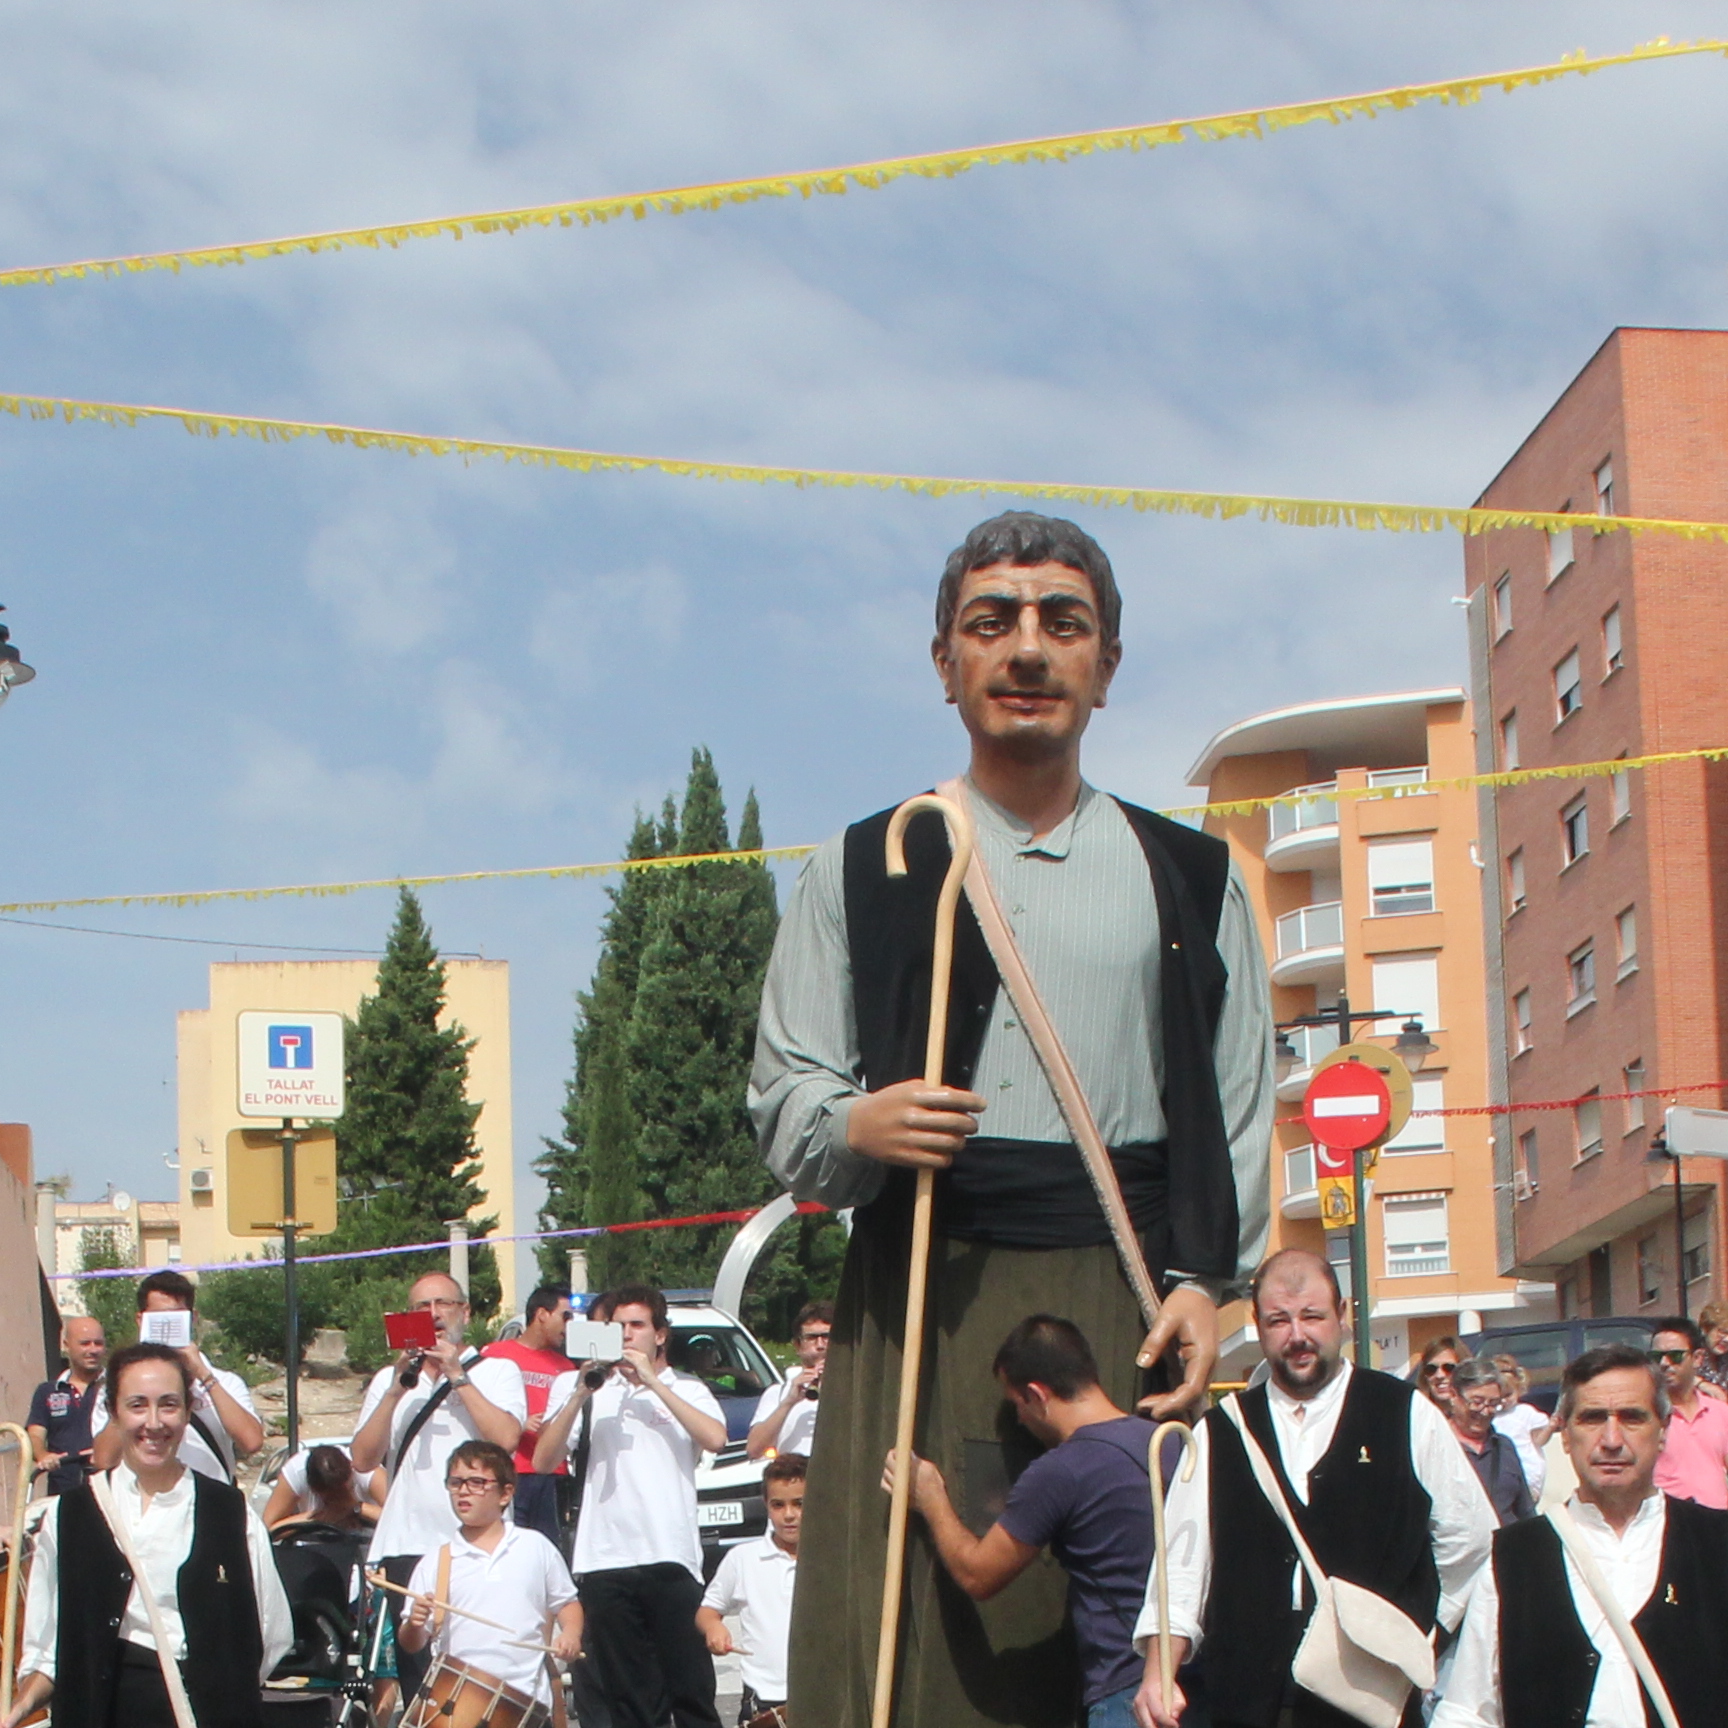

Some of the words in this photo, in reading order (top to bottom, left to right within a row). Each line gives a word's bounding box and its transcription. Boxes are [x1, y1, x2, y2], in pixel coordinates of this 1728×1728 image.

[267, 1078, 316, 1091] TALLAT
[244, 1093, 261, 1105] EL
[265, 1093, 302, 1105] PONT
[305, 1094, 339, 1106] VELL
[707, 1505, 738, 1523] HZH
